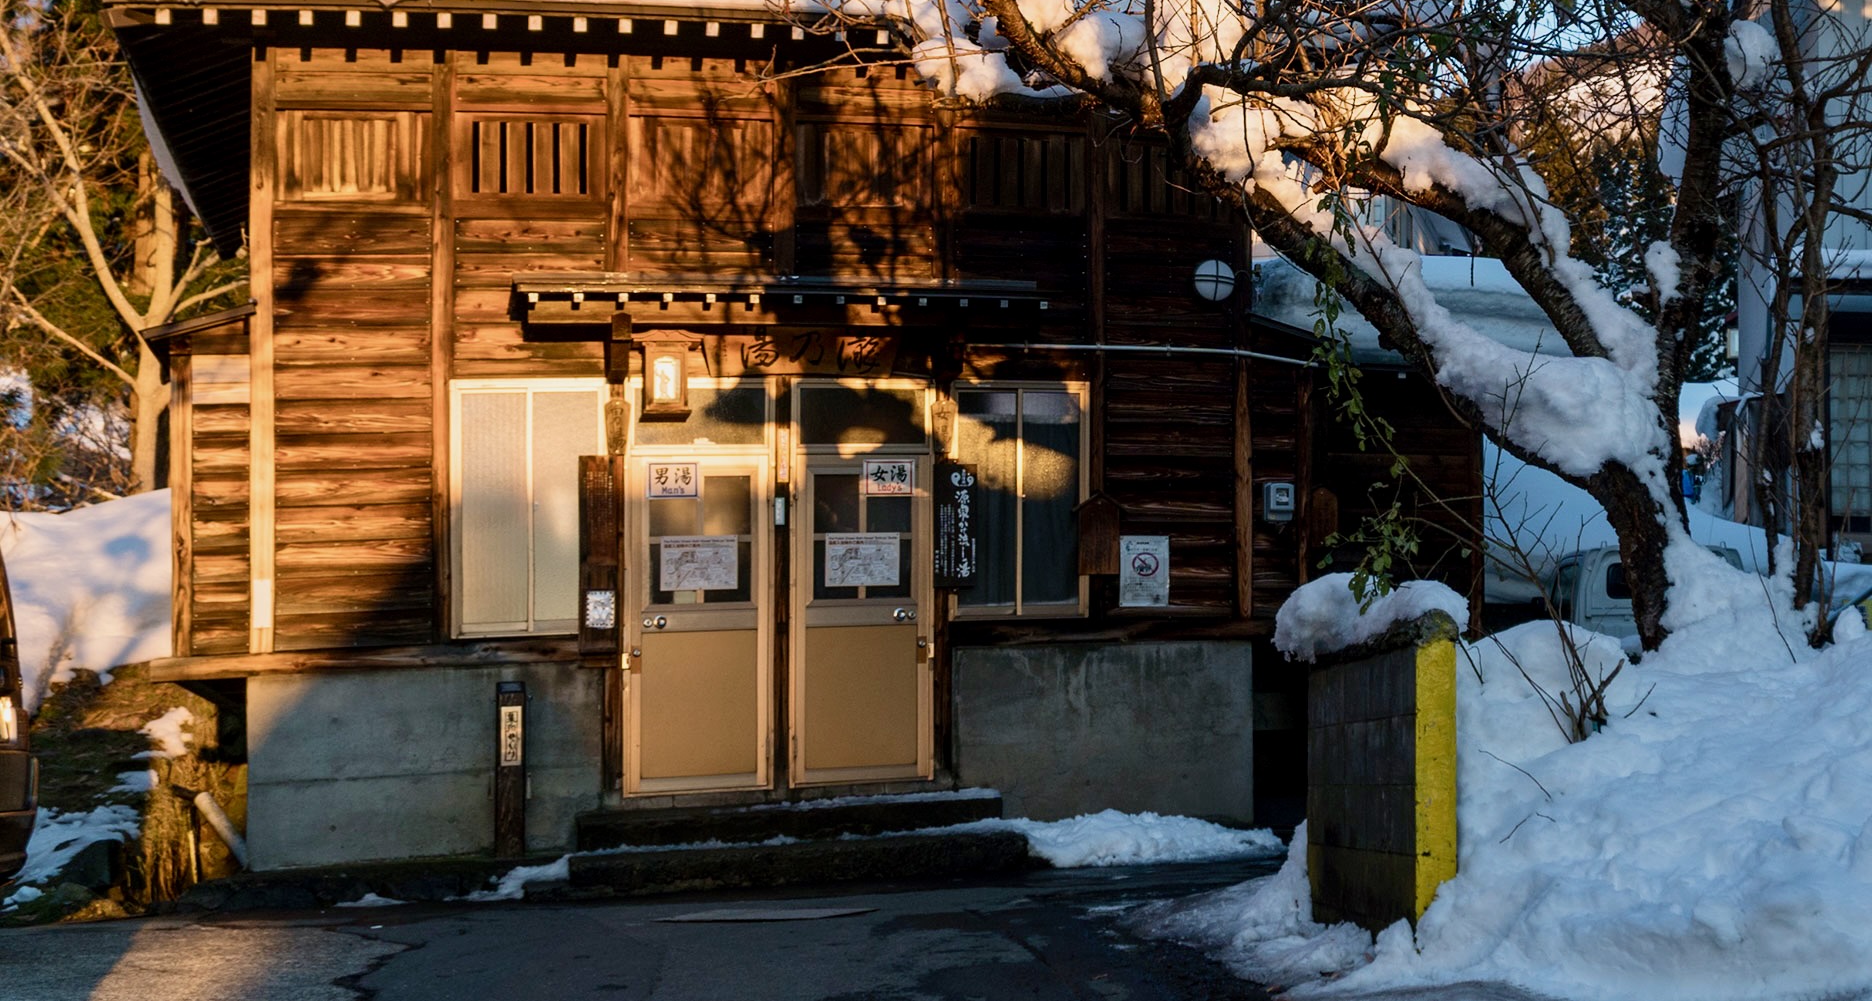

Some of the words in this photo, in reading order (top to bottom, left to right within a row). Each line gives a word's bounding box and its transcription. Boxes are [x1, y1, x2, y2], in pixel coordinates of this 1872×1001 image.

[654, 466, 692, 485] 男湯
[870, 464, 908, 483] 女湯
[661, 486, 686, 495] Man's
[877, 482, 903, 493] Lady's
